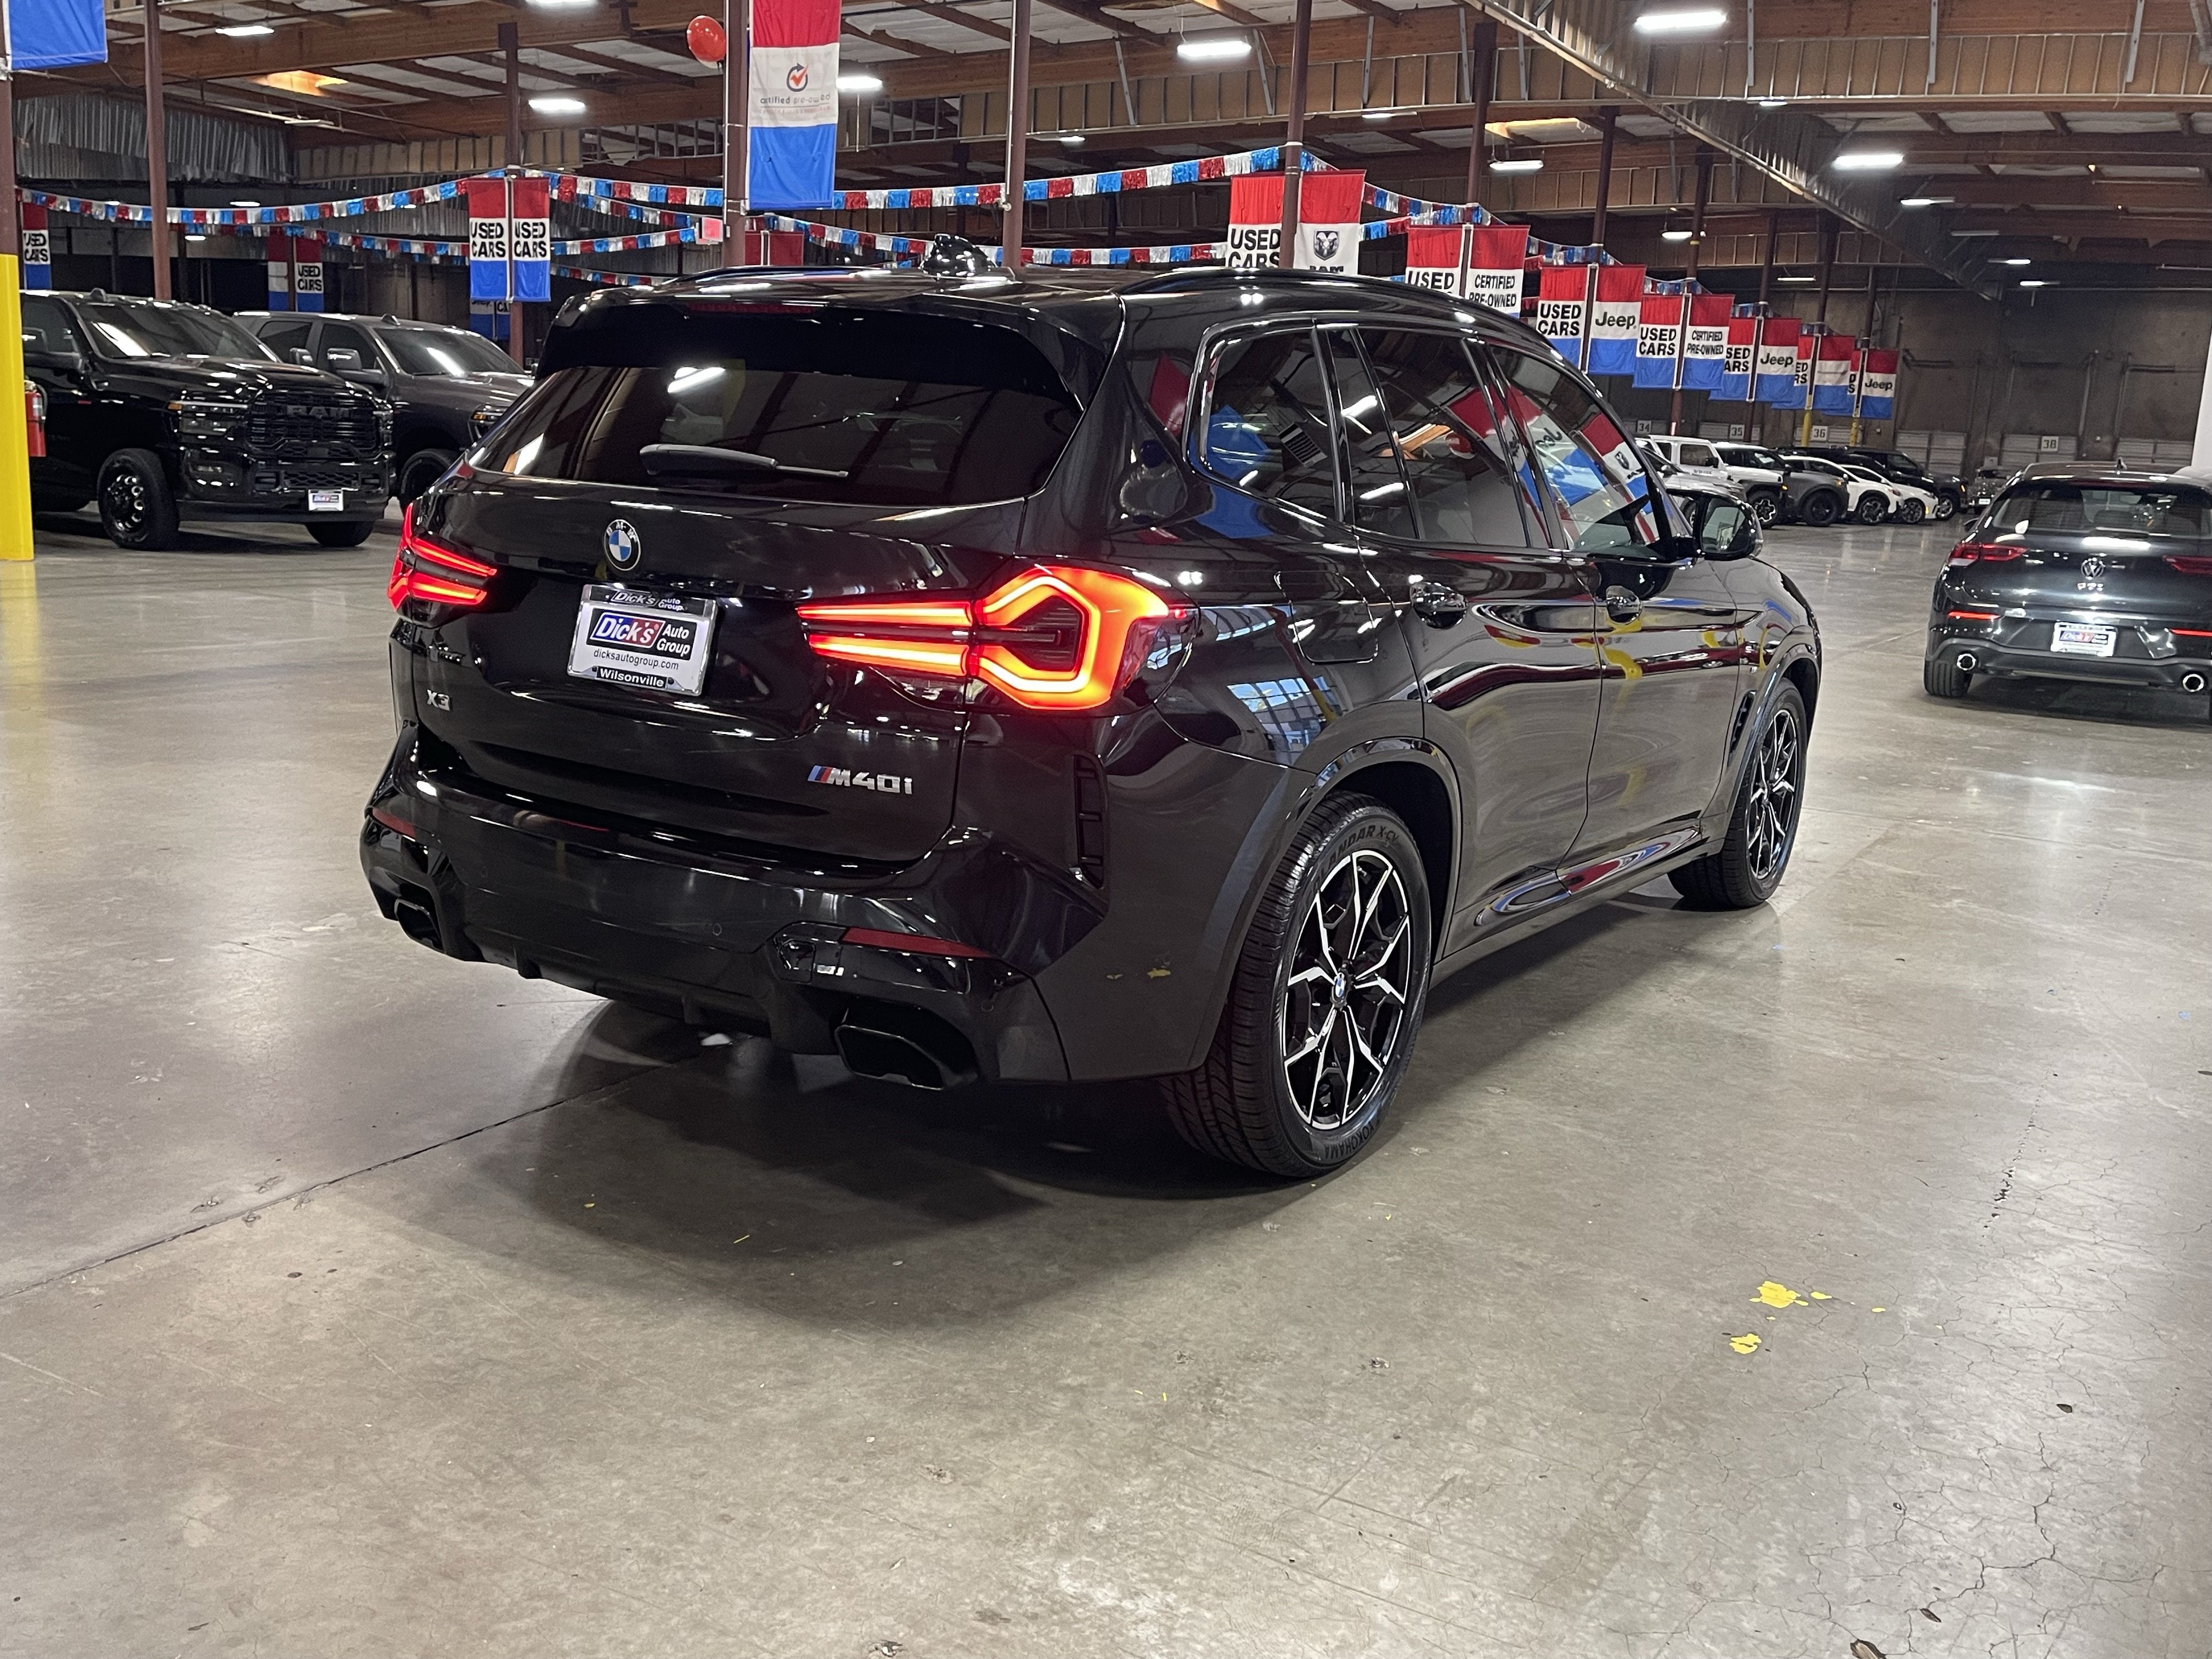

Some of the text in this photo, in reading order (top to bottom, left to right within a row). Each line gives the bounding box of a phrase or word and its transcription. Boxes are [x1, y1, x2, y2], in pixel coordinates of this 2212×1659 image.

[471, 222, 504, 239] USED
[515, 222, 546, 239] USED
[1231, 228, 1281, 250] USED
[472, 240, 506, 257] CARS
[514, 240, 546, 257] CARS
[1408, 270, 1454, 290] USED
[1475, 274, 1515, 289] CERTIFIED
[1540, 303, 1582, 319] USED
[1538, 320, 1580, 336] CARS
[1595, 312, 1636, 330] Jeep
[1640, 328, 1677, 341] USED
[1691, 330, 1723, 341] CERTIFIED
[1639, 341, 1676, 356] CARS
[1686, 343, 1724, 355] PRE-OWNED
[1726, 347, 1751, 359] SED
[1724, 360, 1750, 372] ARS
[1760, 353, 1794, 368] Jeep
[1865, 379, 1893, 391] Jeep
[1639, 423, 1650, 432] 34
[1731, 427, 1742, 436] 35
[1813, 428, 1826, 438] 36
[2043, 440, 2056, 449] 38
[614, 592, 656, 605] Dick's
[658, 602, 684, 611] Group
[596, 617, 654, 644] Dick's
[663, 624, 689, 639] Auto
[657, 638, 690, 657] Group
[594, 648, 679, 670] dicksautogroup.com
[600, 668, 664, 687] Wilsonville
[427, 689, 450, 711] X3
[1324, 1120, 1375, 1160] YOKOHAMA
